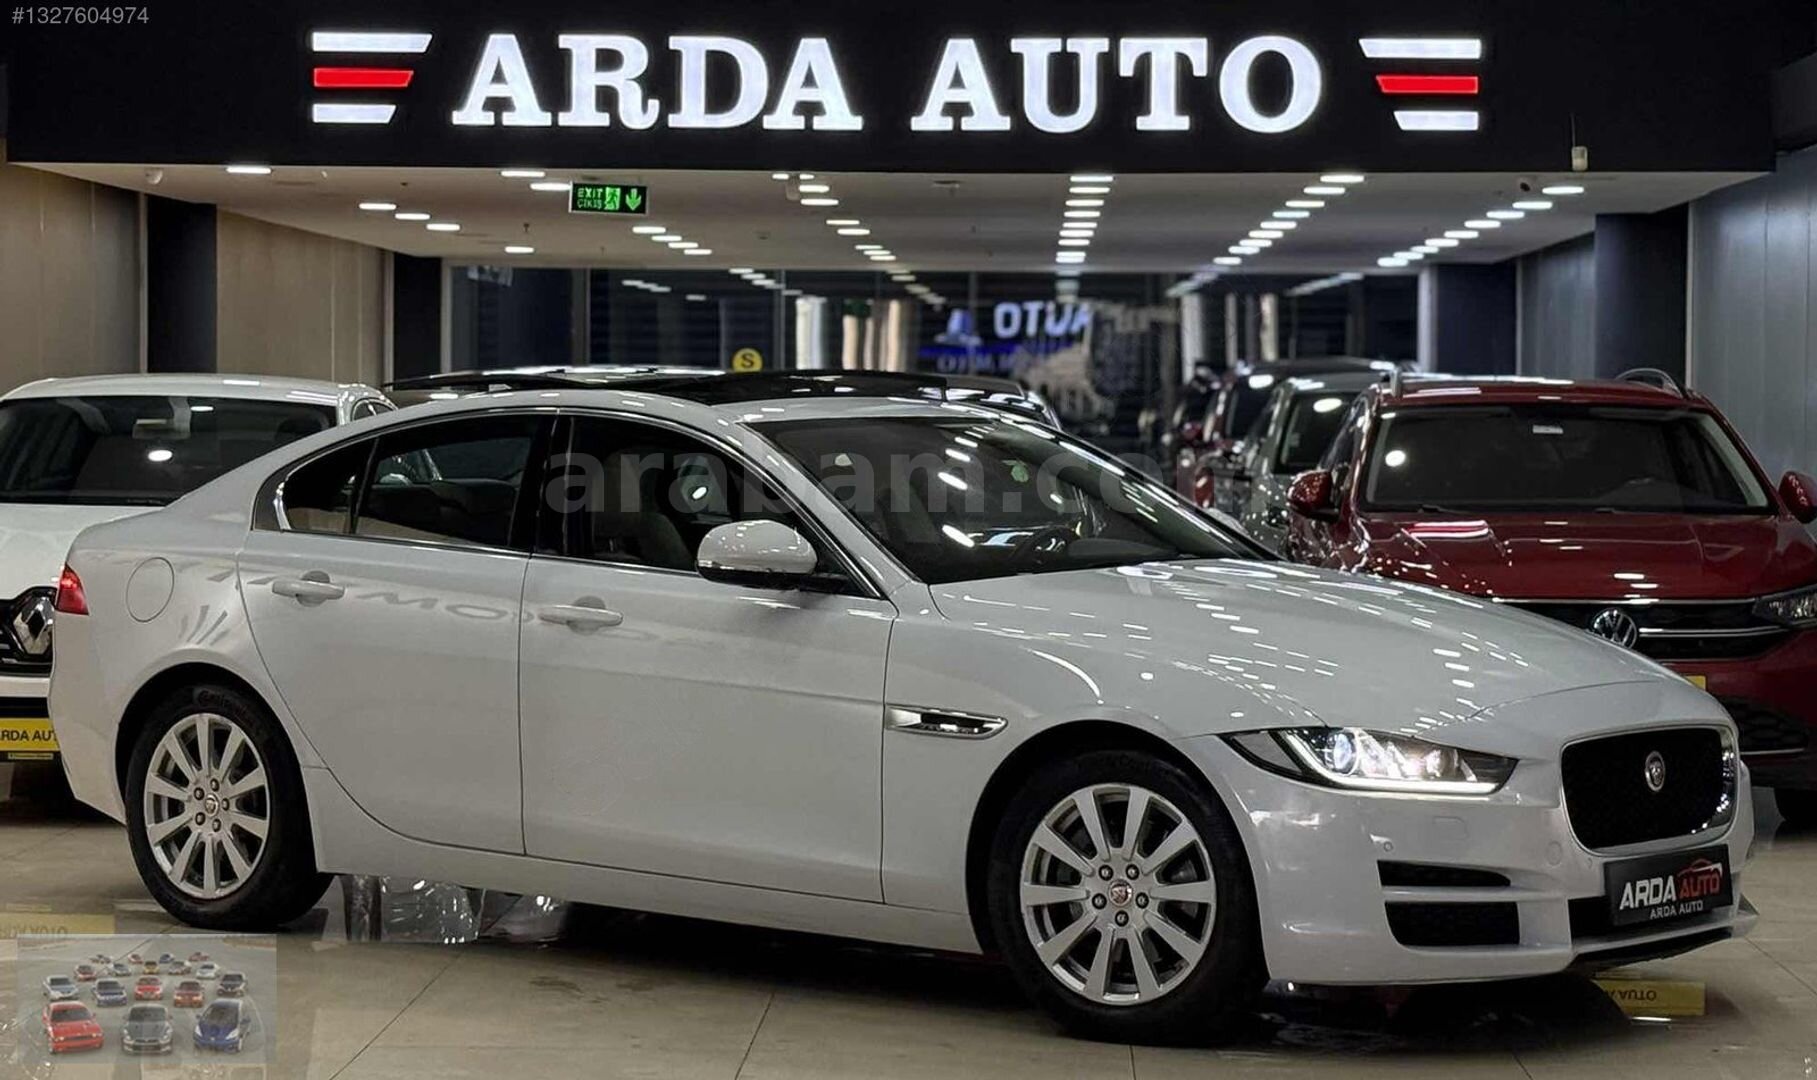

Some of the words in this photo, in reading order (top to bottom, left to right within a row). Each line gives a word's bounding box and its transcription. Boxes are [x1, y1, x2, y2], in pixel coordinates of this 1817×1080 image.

[452, 34, 863, 130] ARDA
[910, 35, 1323, 134] AUTO
[577, 187, 603, 198] EXIT
[0, 729, 29, 742] RDA
[1619, 875, 1677, 910] ARDA
[1680, 871, 1720, 899] AUTO
[1650, 906, 1677, 920] ARDA
[1679, 901, 1704, 915] AUTO
